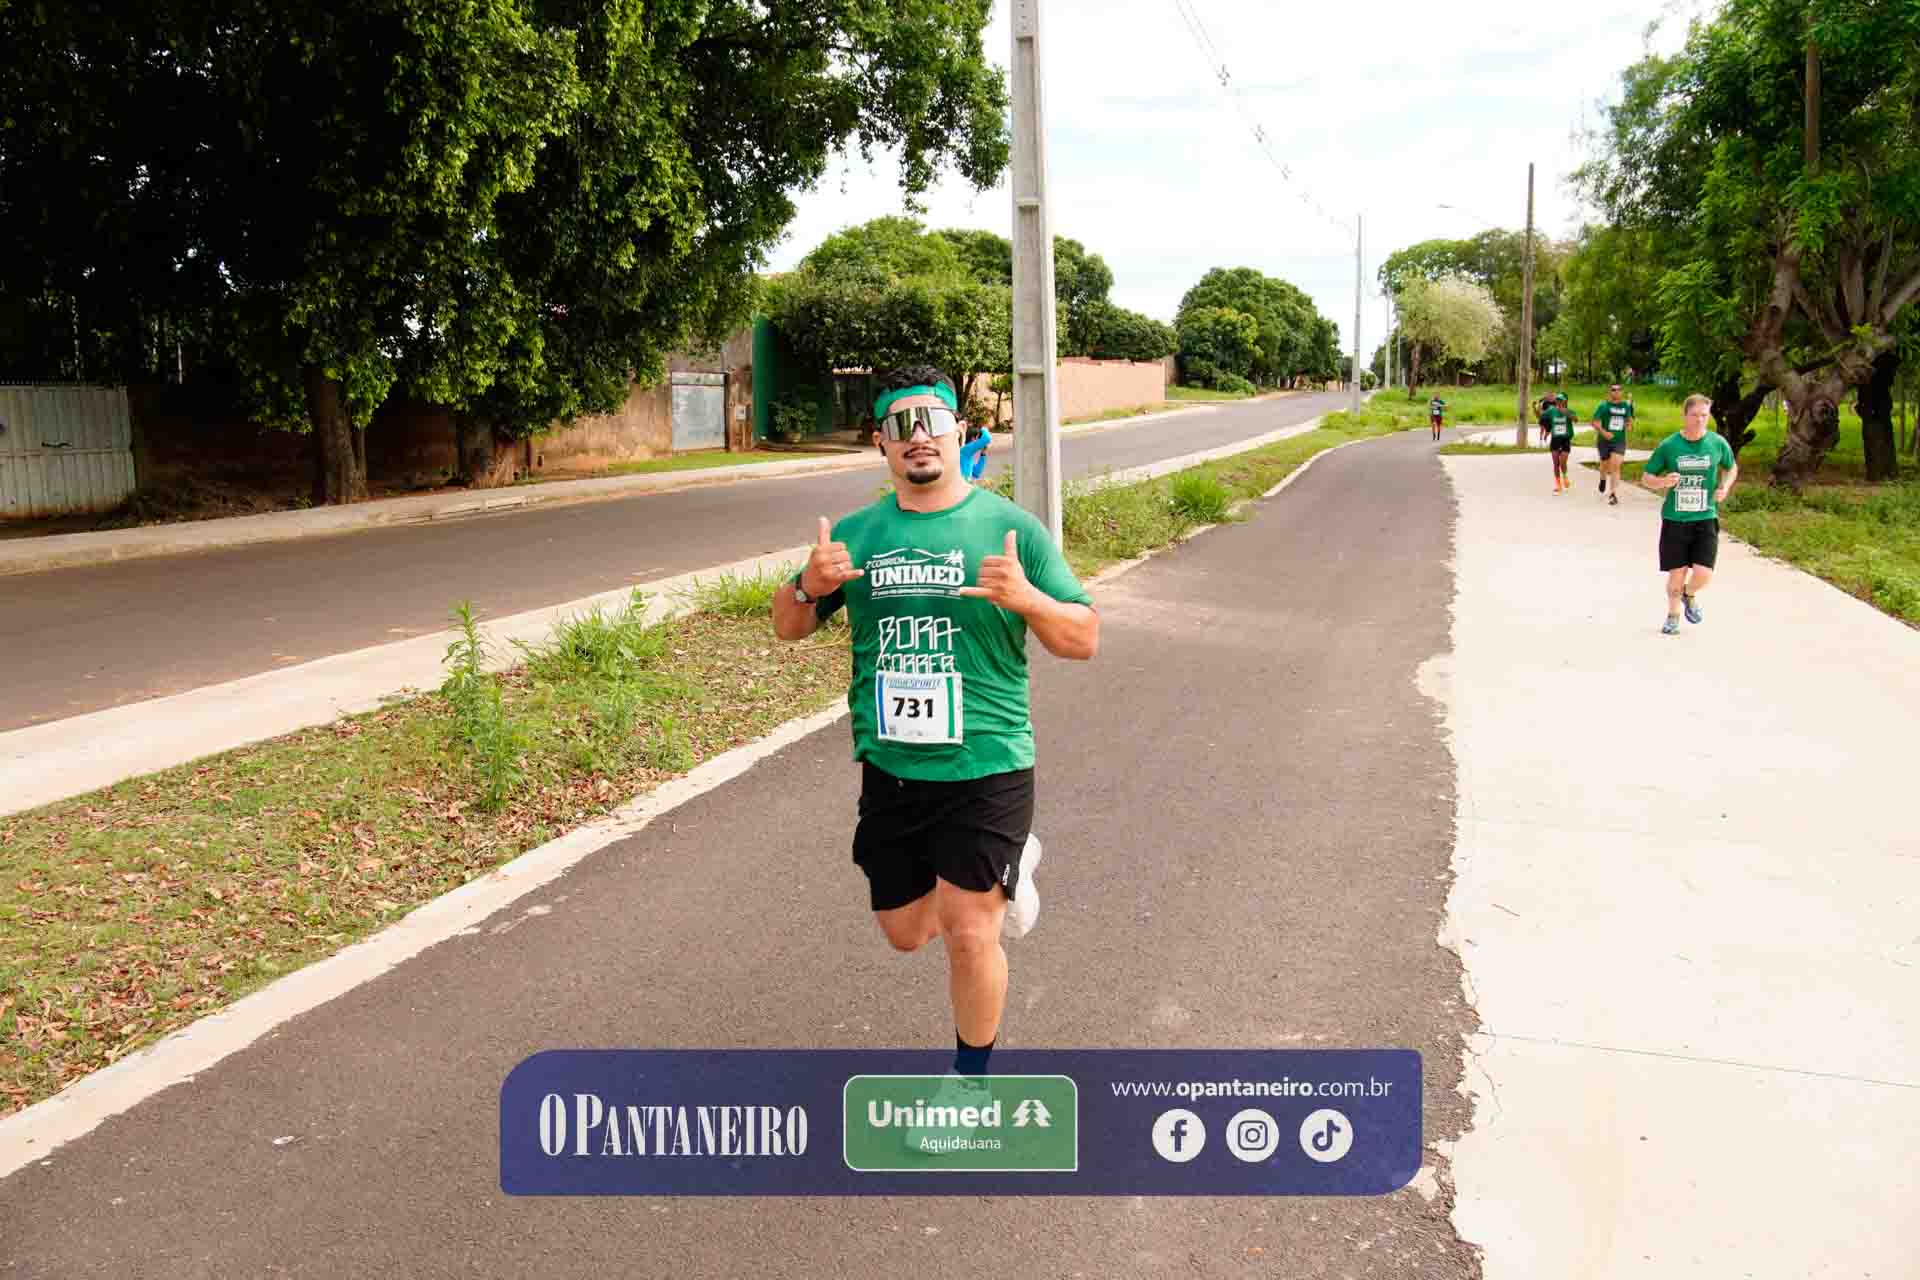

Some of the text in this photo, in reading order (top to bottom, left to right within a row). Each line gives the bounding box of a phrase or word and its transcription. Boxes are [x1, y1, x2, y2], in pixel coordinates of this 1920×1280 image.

[870, 565, 965, 587] UNIMED
[878, 615, 961, 656] BORA
[893, 696, 934, 718] 731
